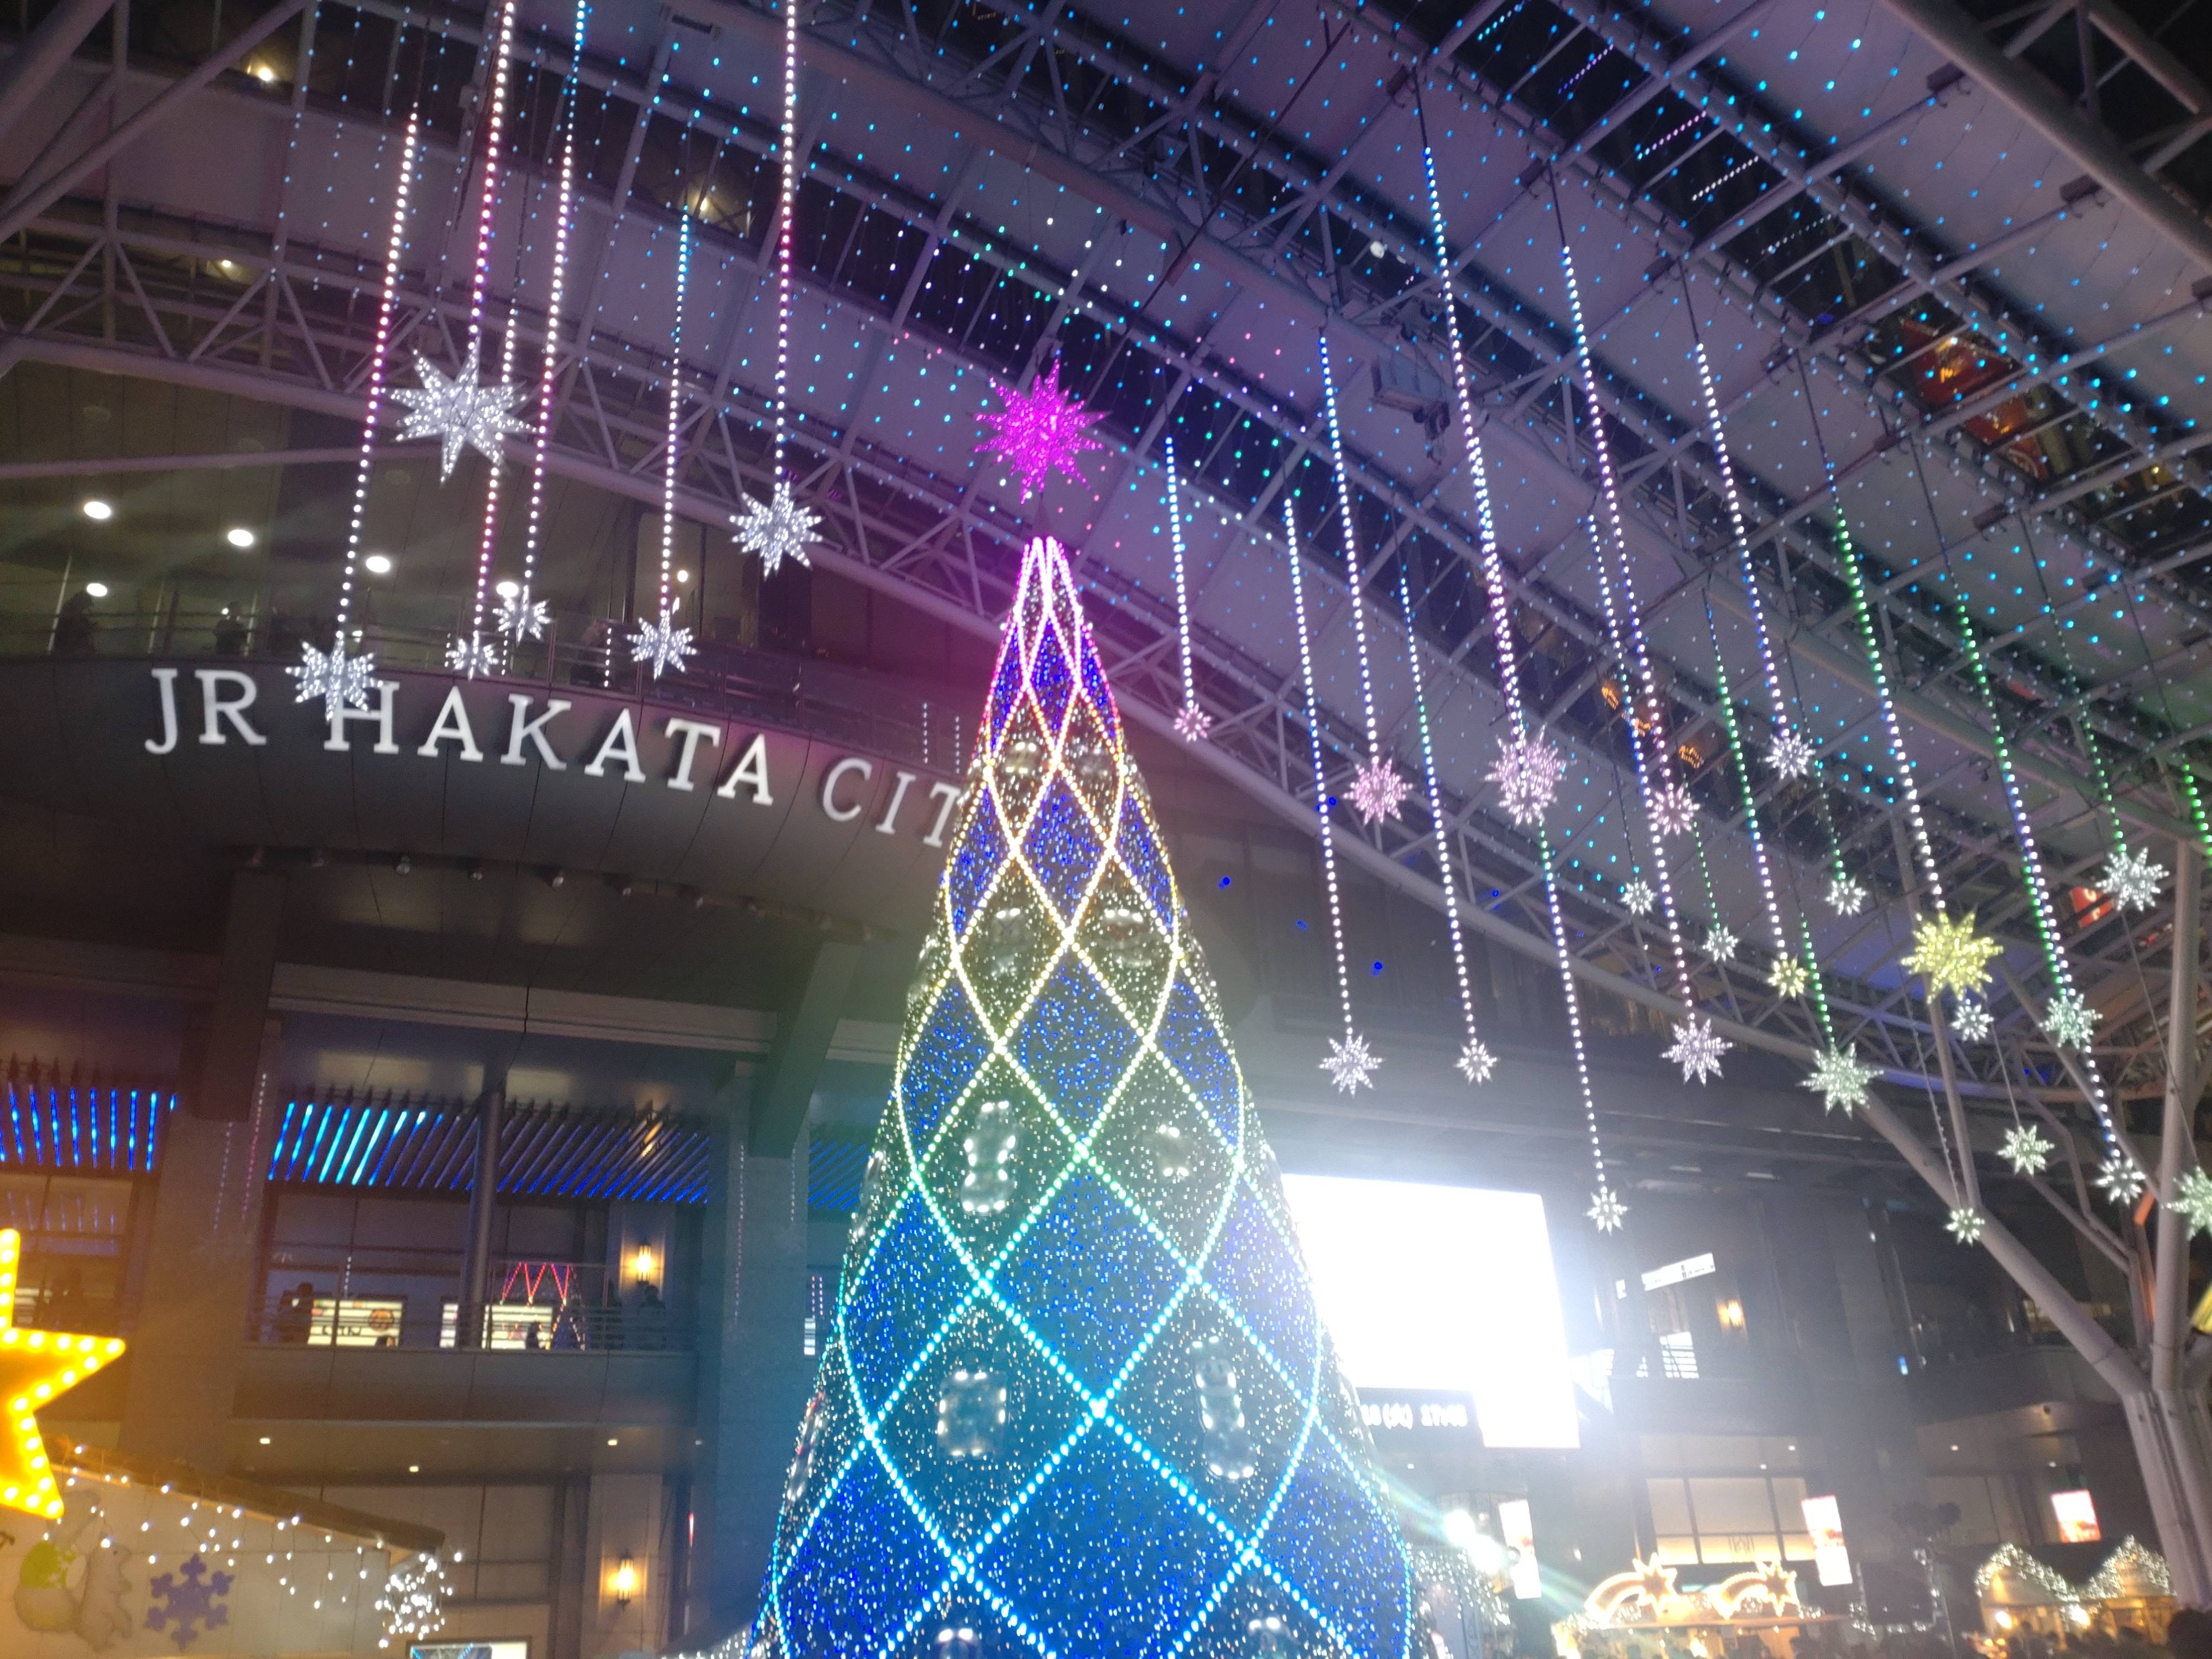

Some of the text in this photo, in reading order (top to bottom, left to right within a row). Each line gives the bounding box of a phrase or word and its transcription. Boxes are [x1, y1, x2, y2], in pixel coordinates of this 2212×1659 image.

[144, 668, 962, 848] JR HAKATA CIT
